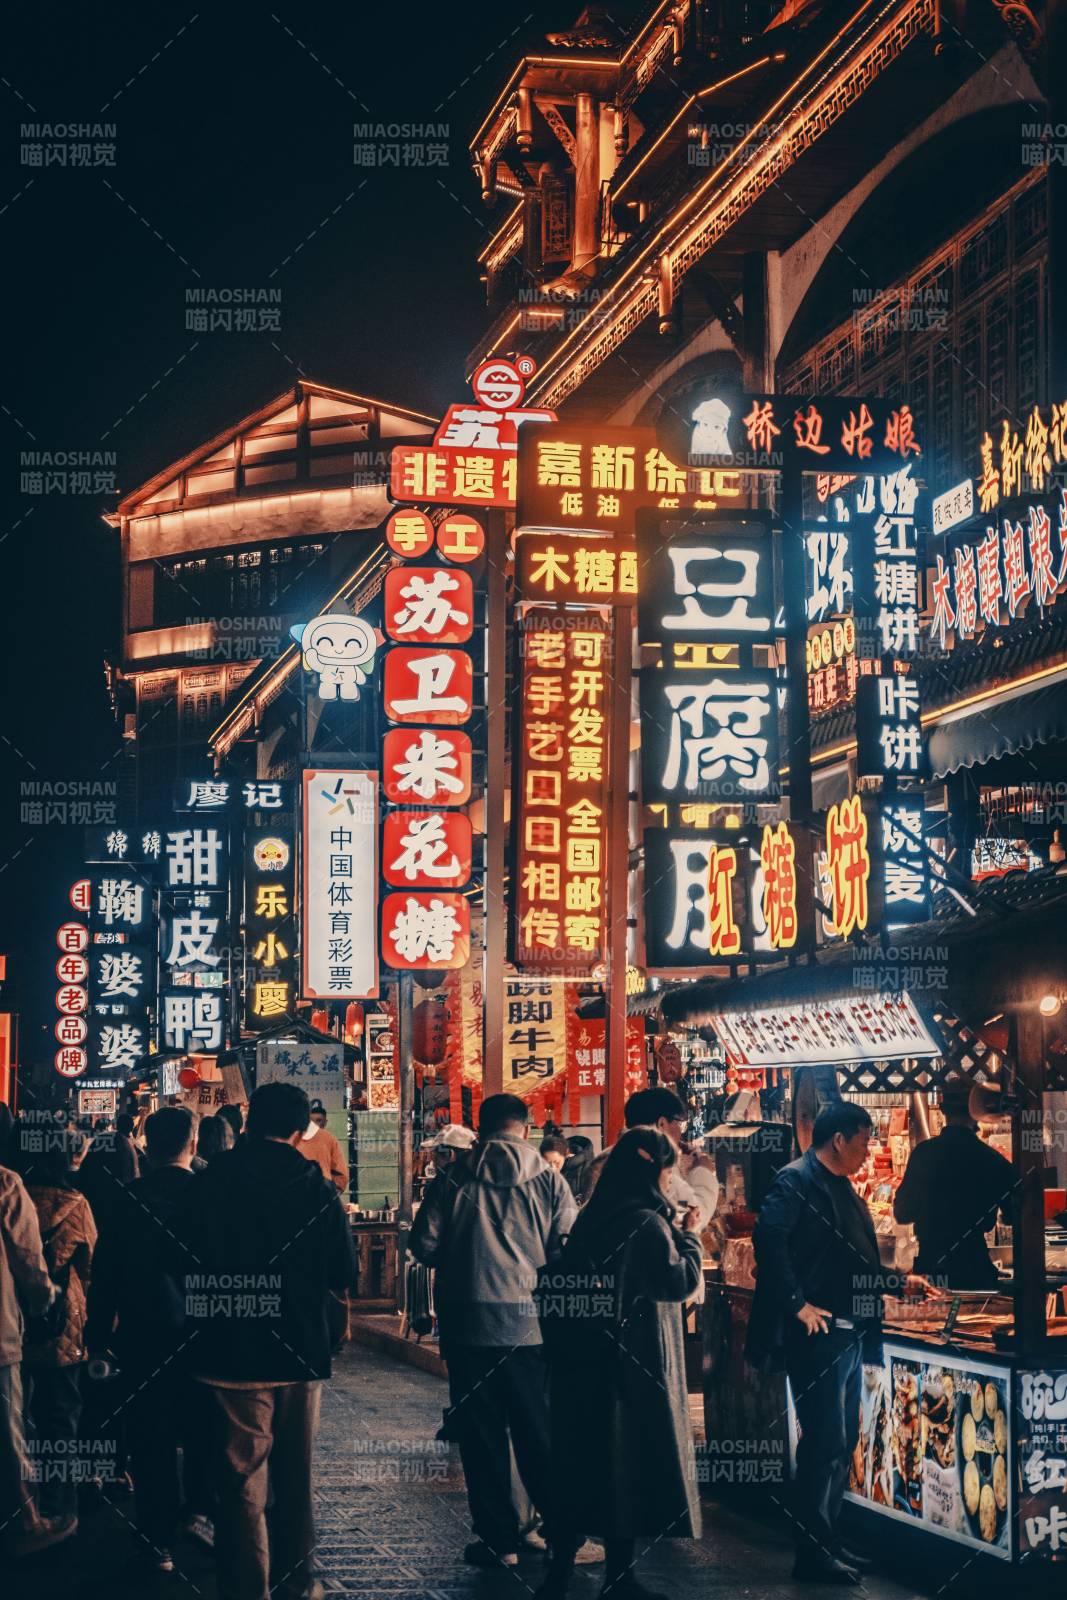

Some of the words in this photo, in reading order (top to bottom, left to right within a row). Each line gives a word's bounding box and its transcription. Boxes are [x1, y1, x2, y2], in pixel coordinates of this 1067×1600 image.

[742, 400, 923, 461] 桥边姑娘
[393, 517, 479, 555] 手工
[873, 513, 918, 652] 红糖饼
[389, 571, 469, 963] 苏卫米花糖
[567, 631, 606, 783] 可开发票
[186, 780, 284, 809] 廖记
[164, 828, 224, 1050] 甜皮鸭
[327, 825, 354, 991] 中国体育彩票
[564, 797, 603, 952] 全国邮寄
[59, 925, 85, 1074] 百年老品牌
[254, 884, 289, 1017] 乐小廖
